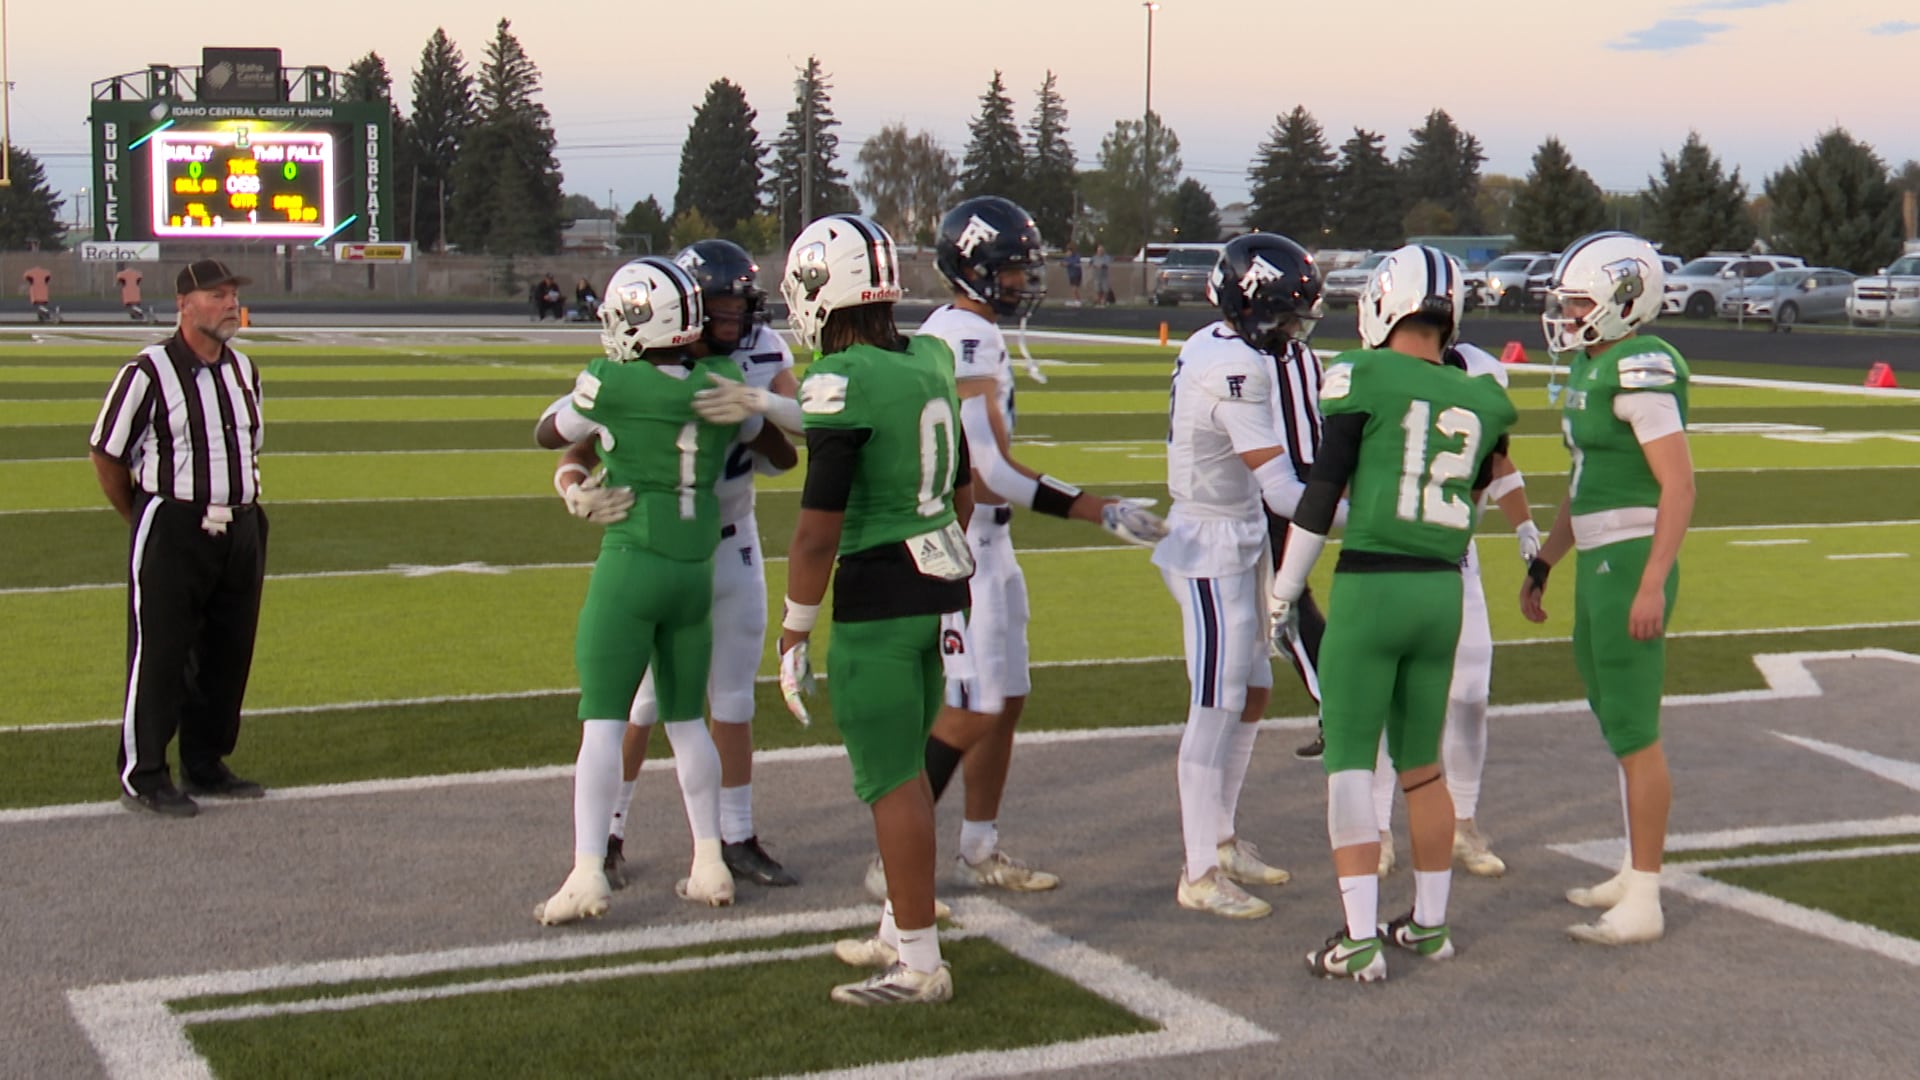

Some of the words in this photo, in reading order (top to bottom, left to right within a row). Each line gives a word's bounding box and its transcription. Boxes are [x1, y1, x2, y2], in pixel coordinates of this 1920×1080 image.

[172, 107, 206, 117] IDAHO
[208, 107, 256, 117] CENTRAL
[258, 107, 295, 117] CREDIT
[298, 107, 333, 118] UNION
[104, 123, 119, 242] BURLEY
[366, 124, 380, 242] BOBCATS
[1396, 399, 1482, 529] 12
